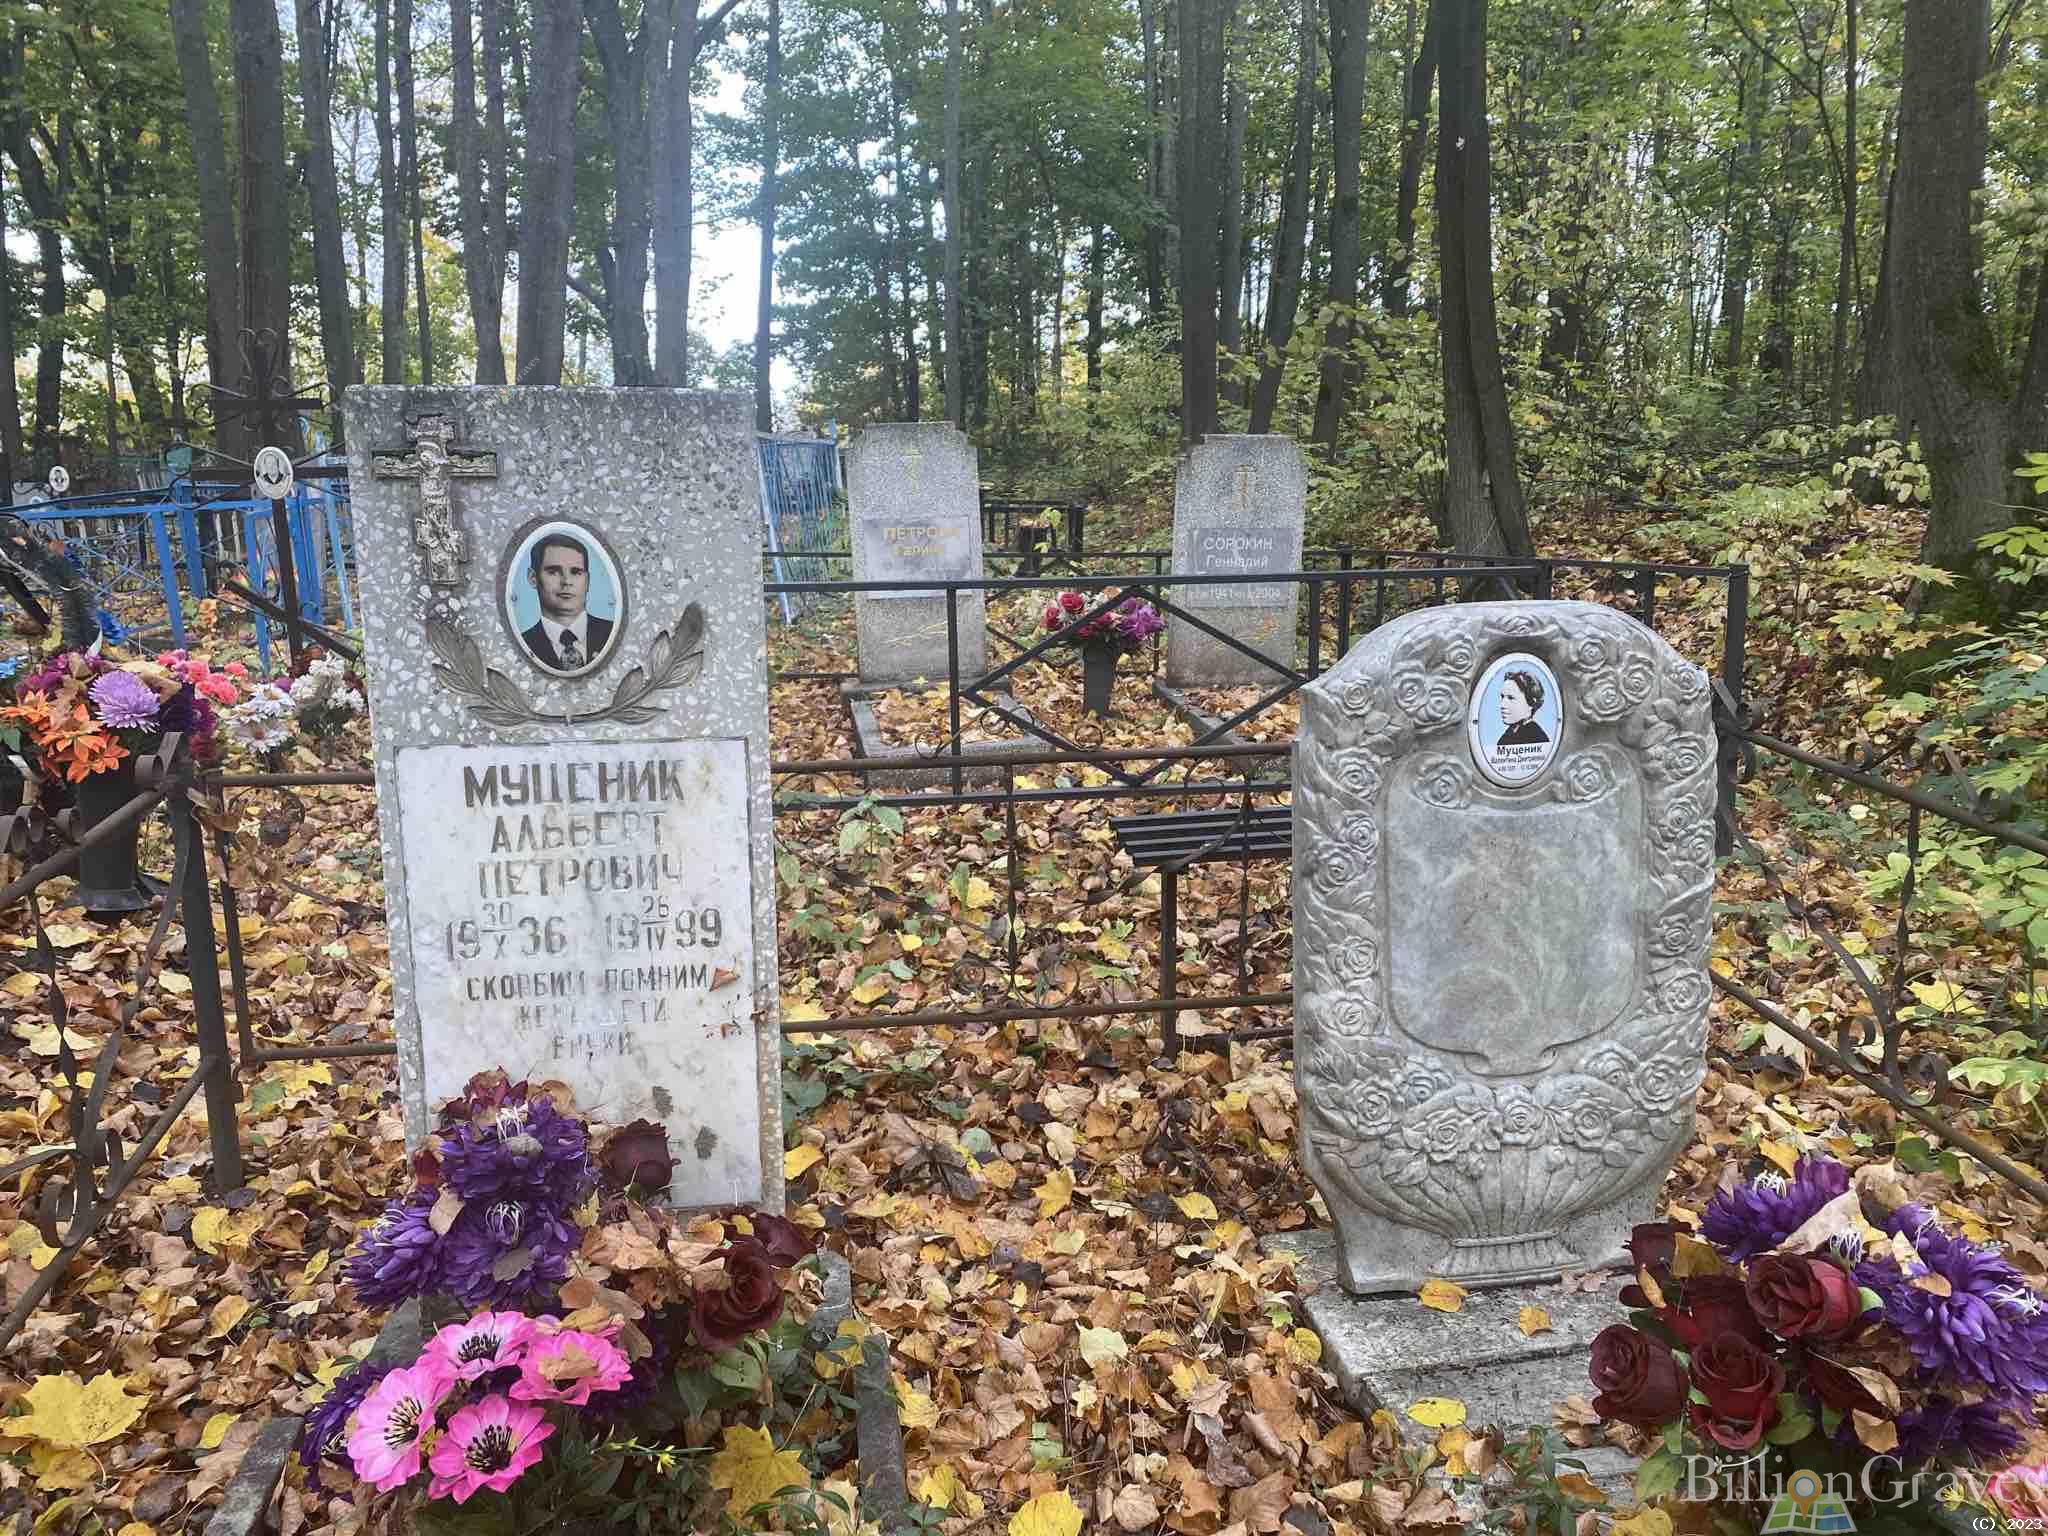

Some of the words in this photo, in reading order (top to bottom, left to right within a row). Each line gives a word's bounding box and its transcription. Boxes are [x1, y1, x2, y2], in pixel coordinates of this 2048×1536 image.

[1203, 536, 1273, 551] СОРОКИН
[1497, 745, 1543, 757] Муценик
[463, 760, 685, 808] МУЦЕНИК
[490, 810, 668, 854] АЛЬБЕРТ
[477, 852, 684, 898] ПЕТРОВИЧ
[603, 963, 708, 994] ПОМНИМ
